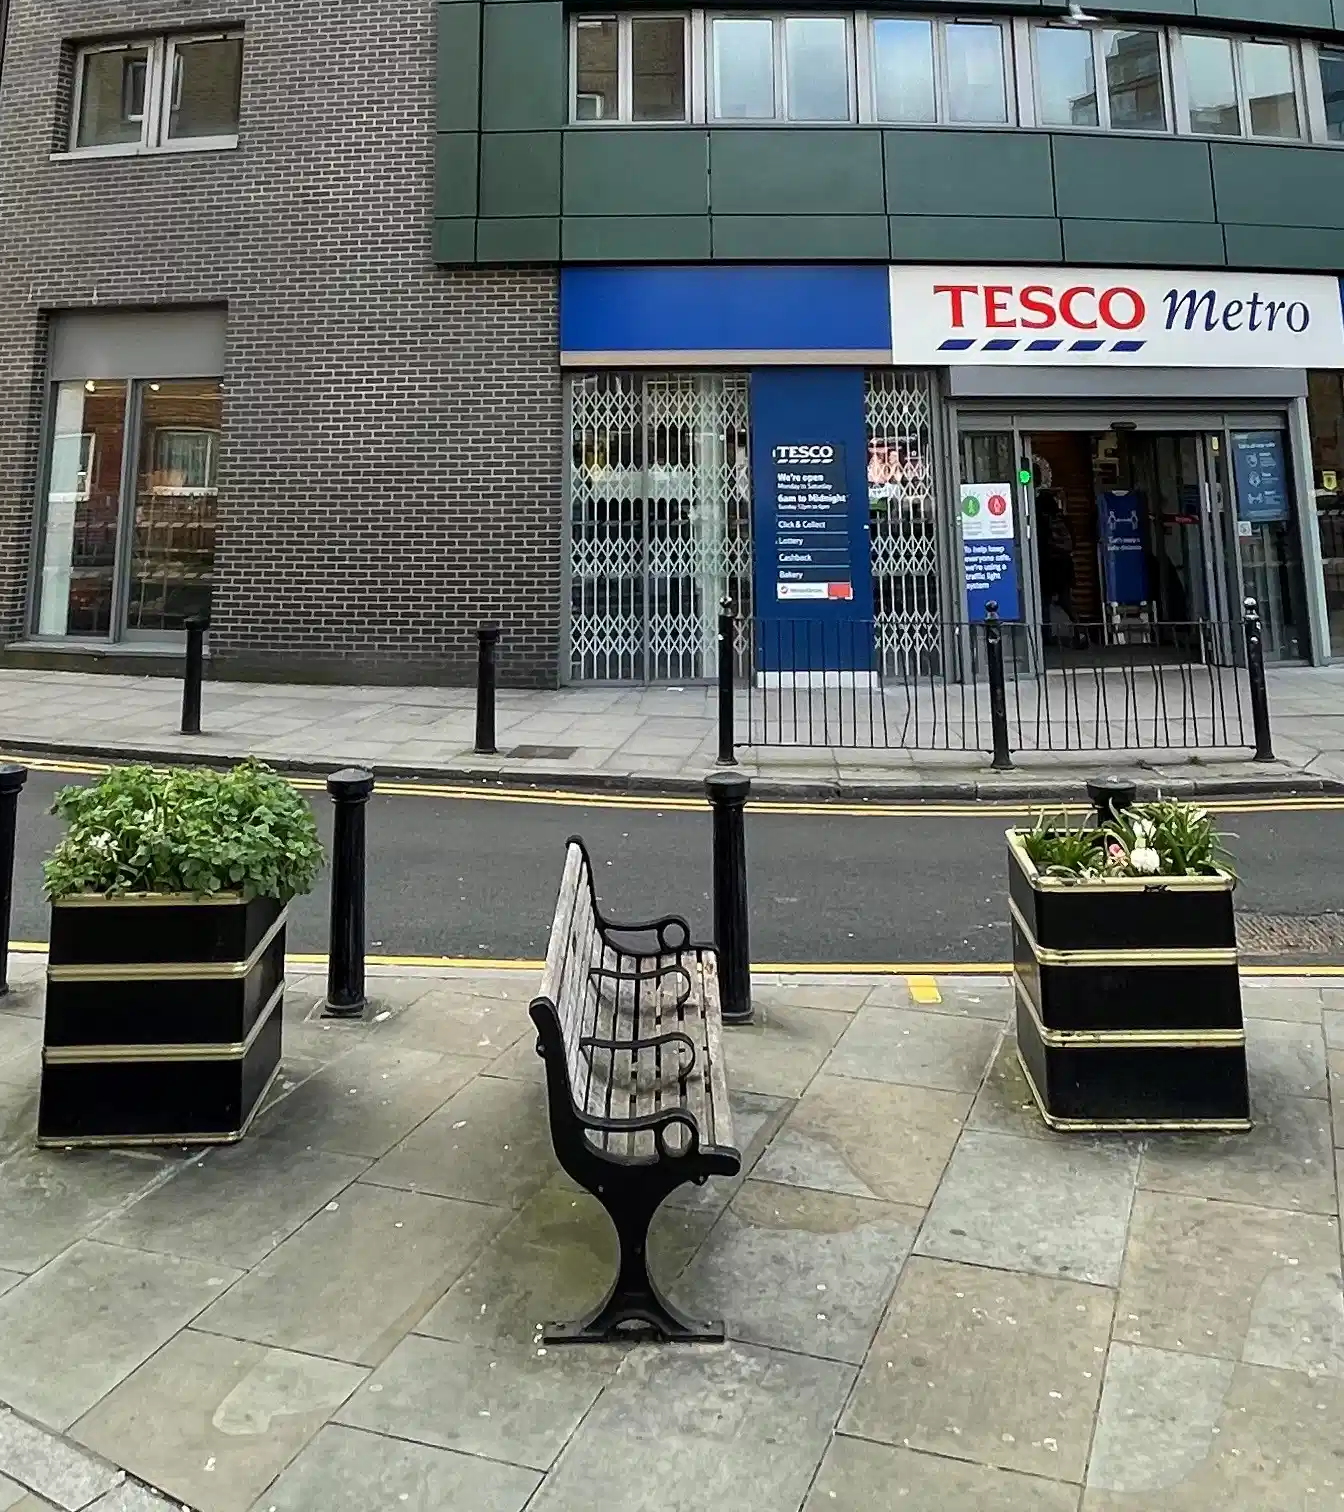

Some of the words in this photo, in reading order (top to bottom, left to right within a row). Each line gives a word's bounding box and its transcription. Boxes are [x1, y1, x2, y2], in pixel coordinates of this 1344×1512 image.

[932, 284, 1146, 330] TESCO
[1162, 288, 1310, 333] Metro
[776, 445, 834, 459] TESCO
[778, 520, 794, 529] Click
[795, 520, 802, 529] &
[802, 520, 826, 529] Collect
[778, 537, 804, 546] Lottery
[779, 553, 813, 562] Cashback
[779, 570, 804, 580] Bakery
